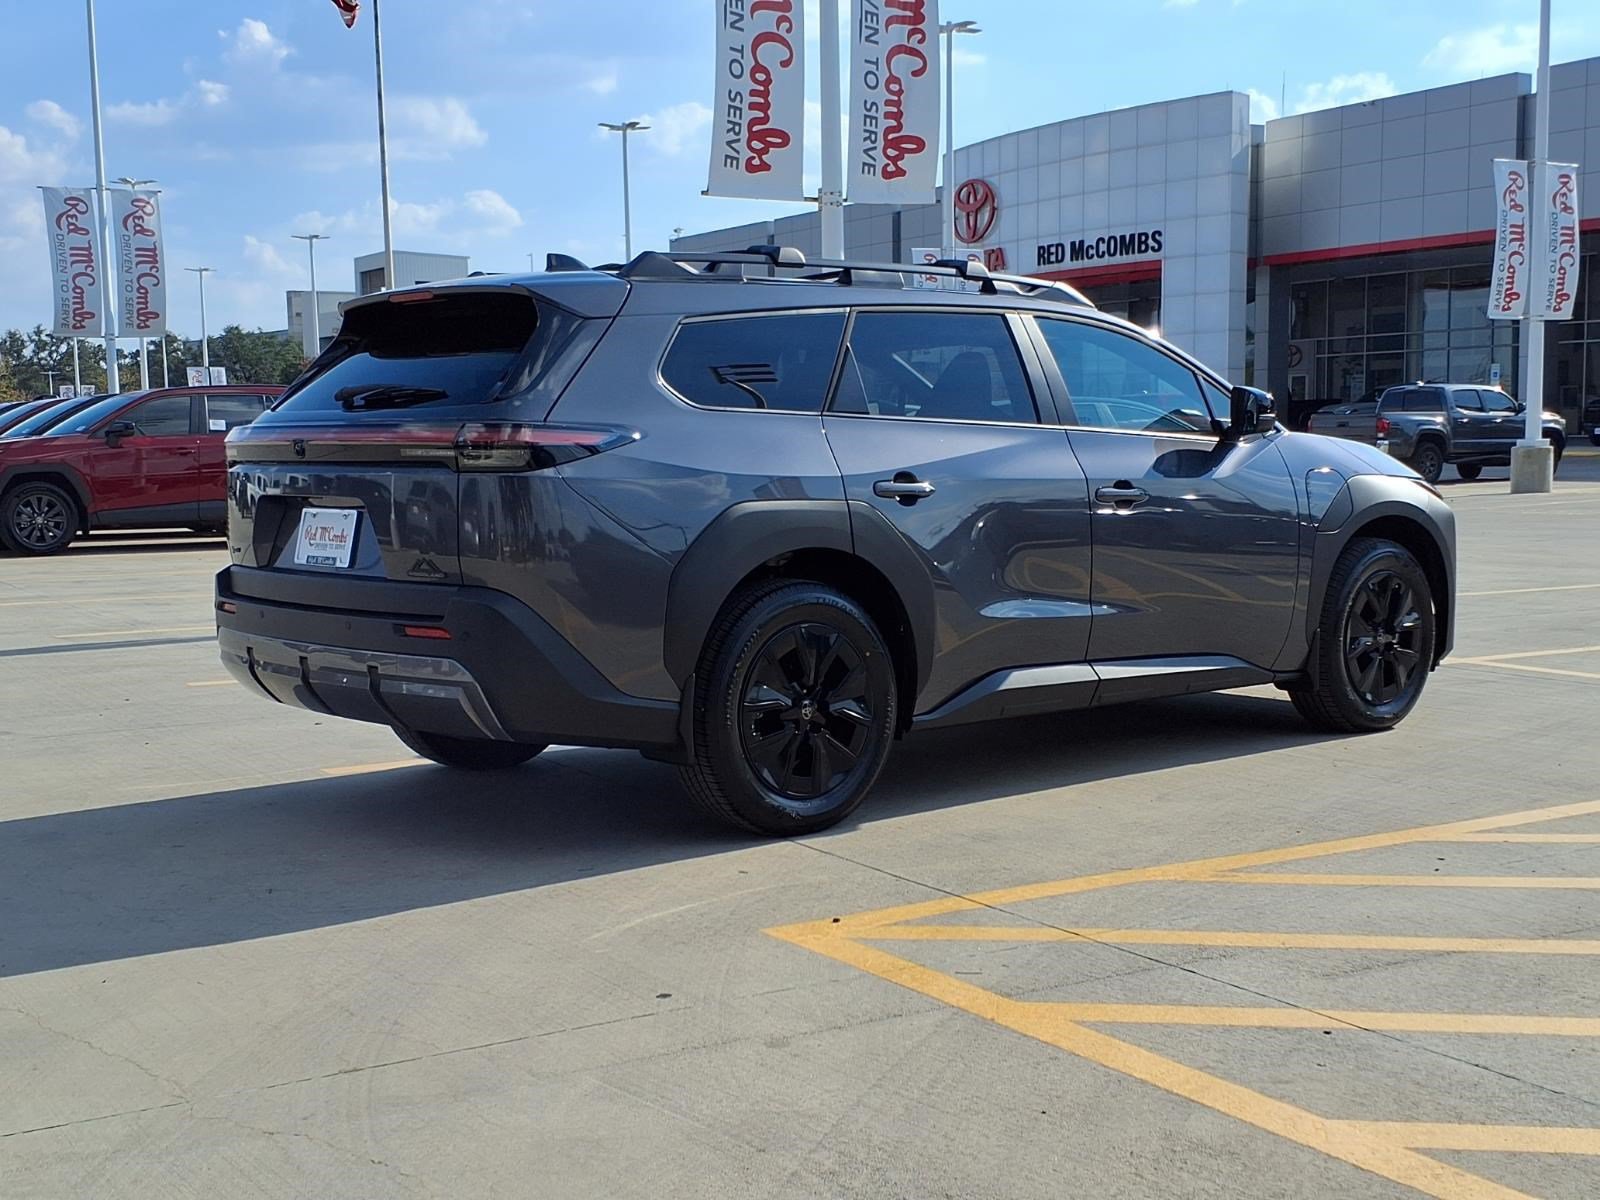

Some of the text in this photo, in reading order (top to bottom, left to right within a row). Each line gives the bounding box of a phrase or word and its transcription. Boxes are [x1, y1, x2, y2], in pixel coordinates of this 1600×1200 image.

[728, 44, 745, 80] TO
[863, 57, 880, 91] TO
[723, 88, 744, 170] SERVE
[861, 99, 880, 176] SERVE
[56, 196, 95, 330] Red McCombs
[56, 233, 70, 329] DRIVEN TO SERVE
[121, 234, 135, 329] DRIVEN TO SERVE
[122, 198, 160, 330] Red McCombs
[1037, 230, 1163, 266] RED McCOMBS
[1493, 209, 1509, 311] DRIVEN TO SERVE
[1501, 170, 1525, 312] Red McCombs
[1545, 212, 1560, 311] DRIVEN TO SERVE
[1552, 173, 1576, 313] Red McCombs
